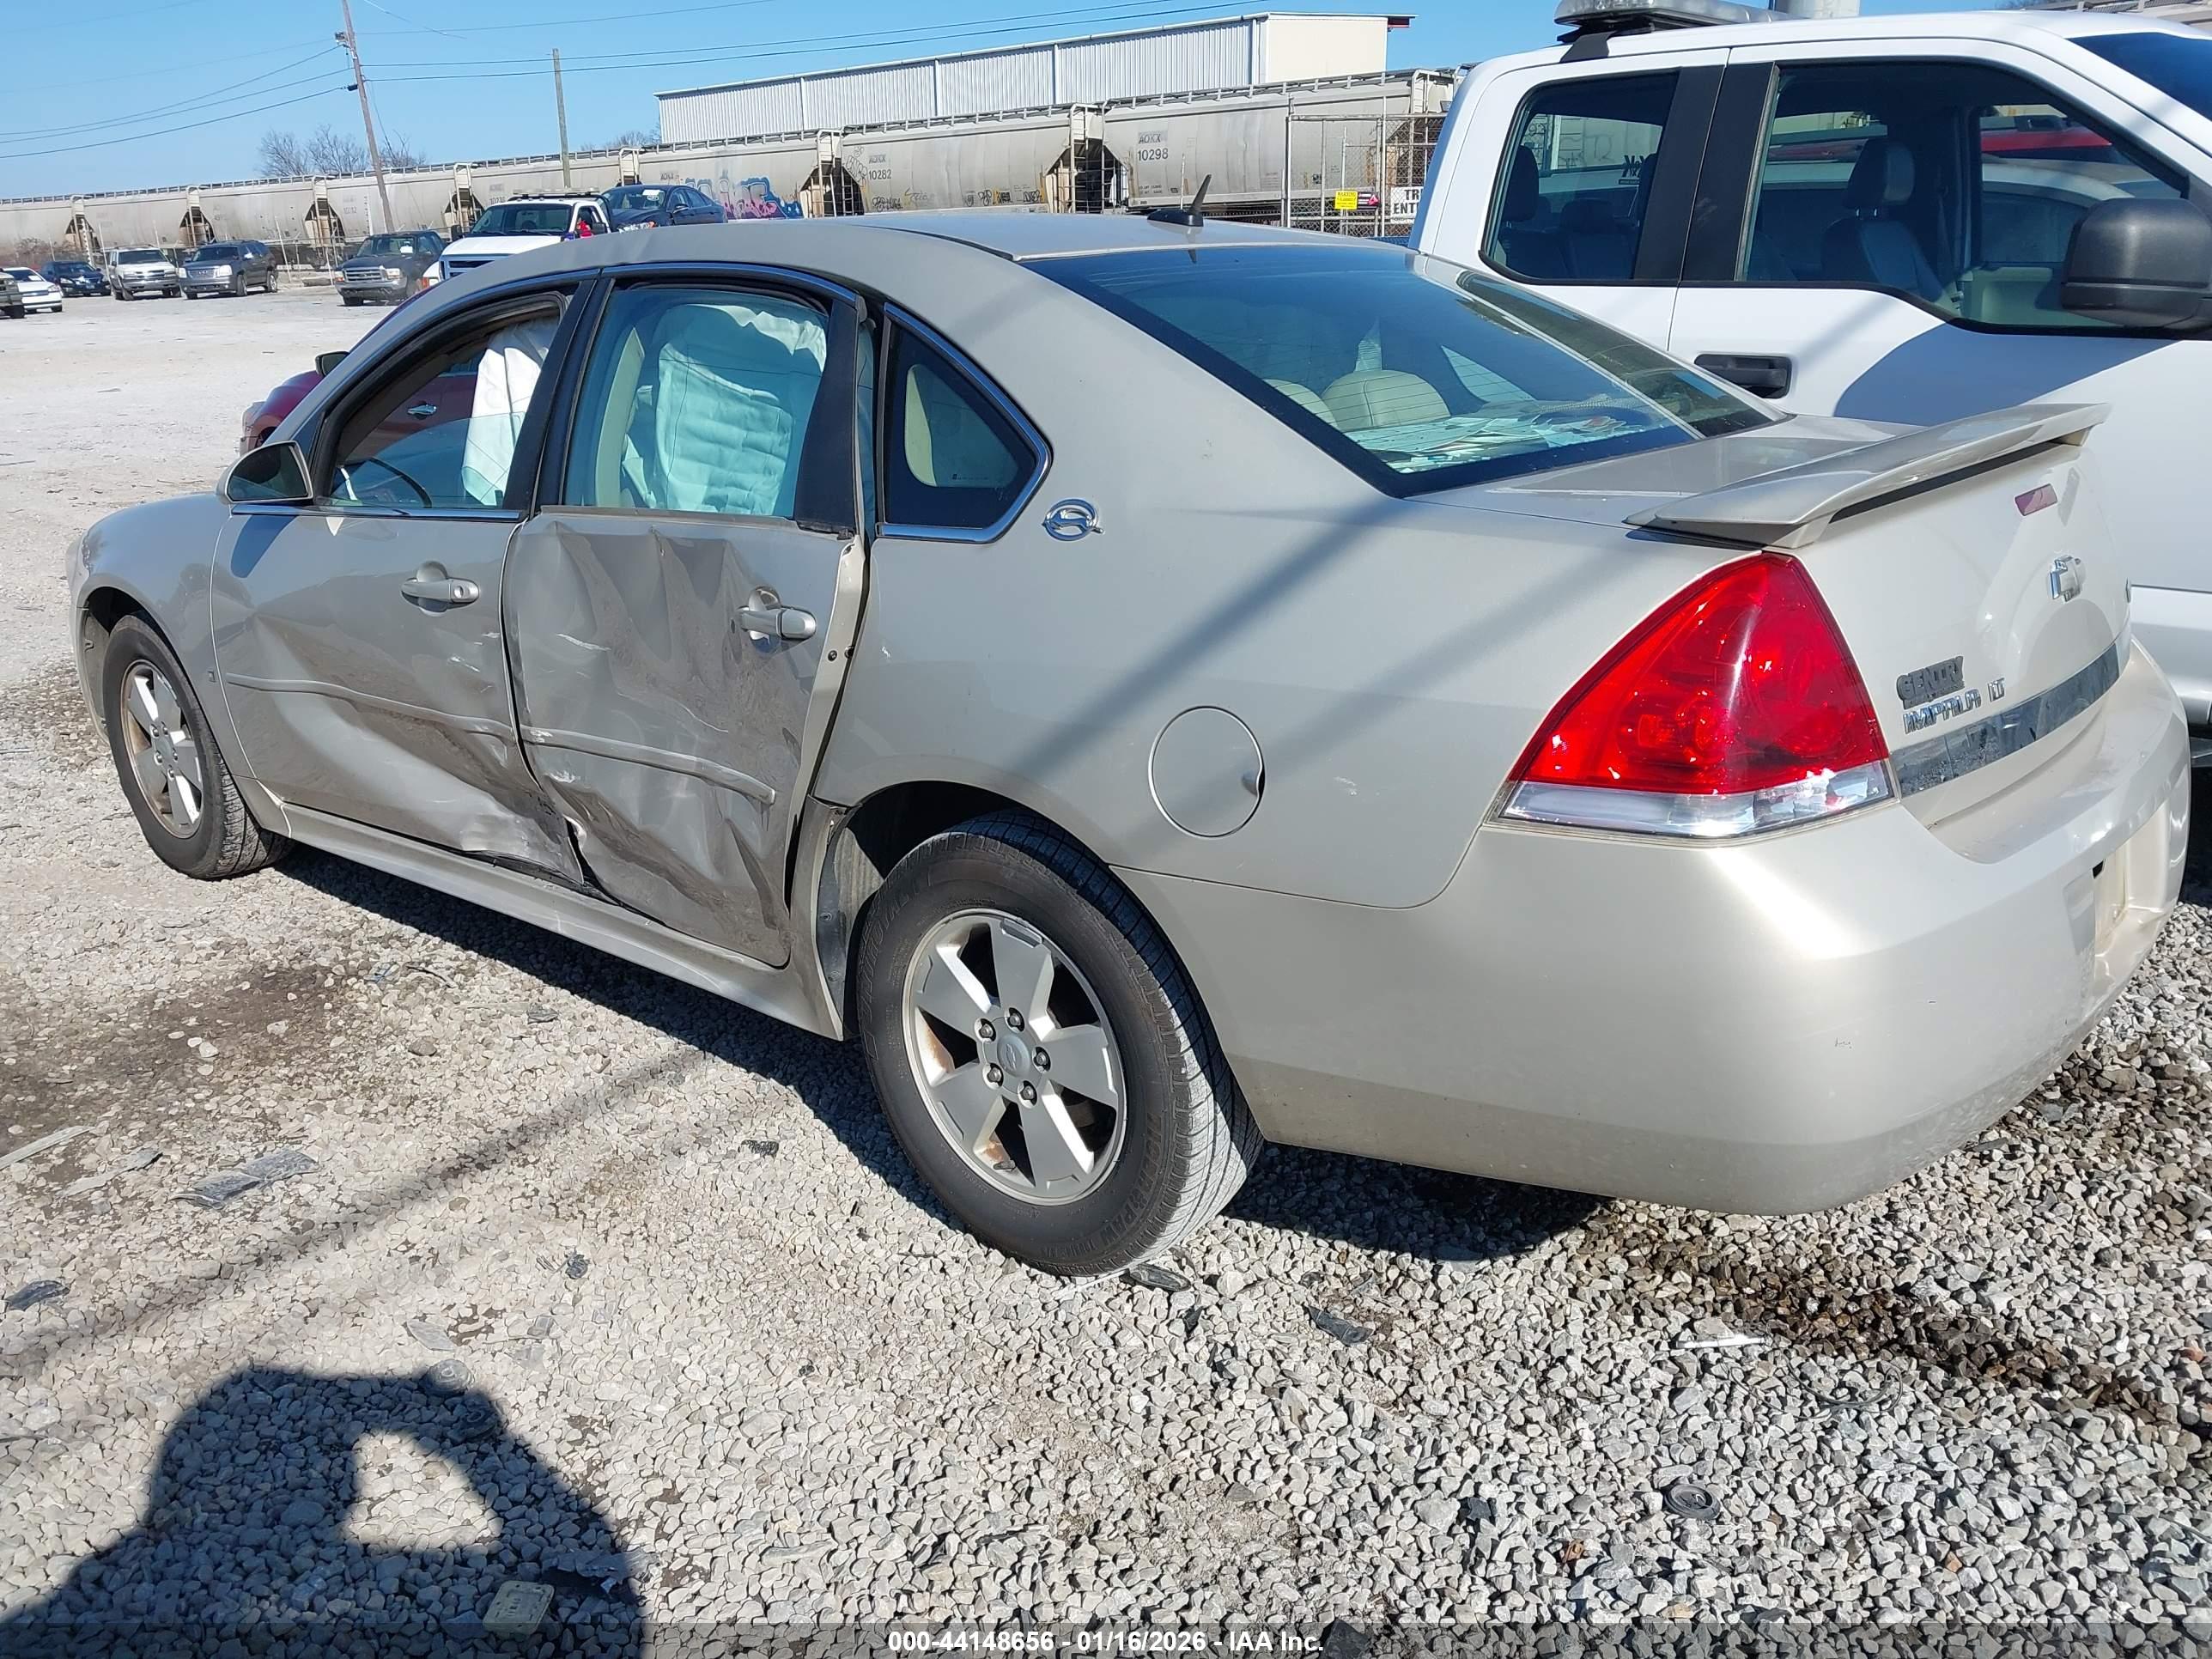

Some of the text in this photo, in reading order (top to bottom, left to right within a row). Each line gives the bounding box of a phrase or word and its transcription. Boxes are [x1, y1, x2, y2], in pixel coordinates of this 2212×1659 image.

[1138, 148, 1169, 161] 10298
[868, 168, 891, 180] 10282
[1903, 689, 1982, 735] IMPALA
